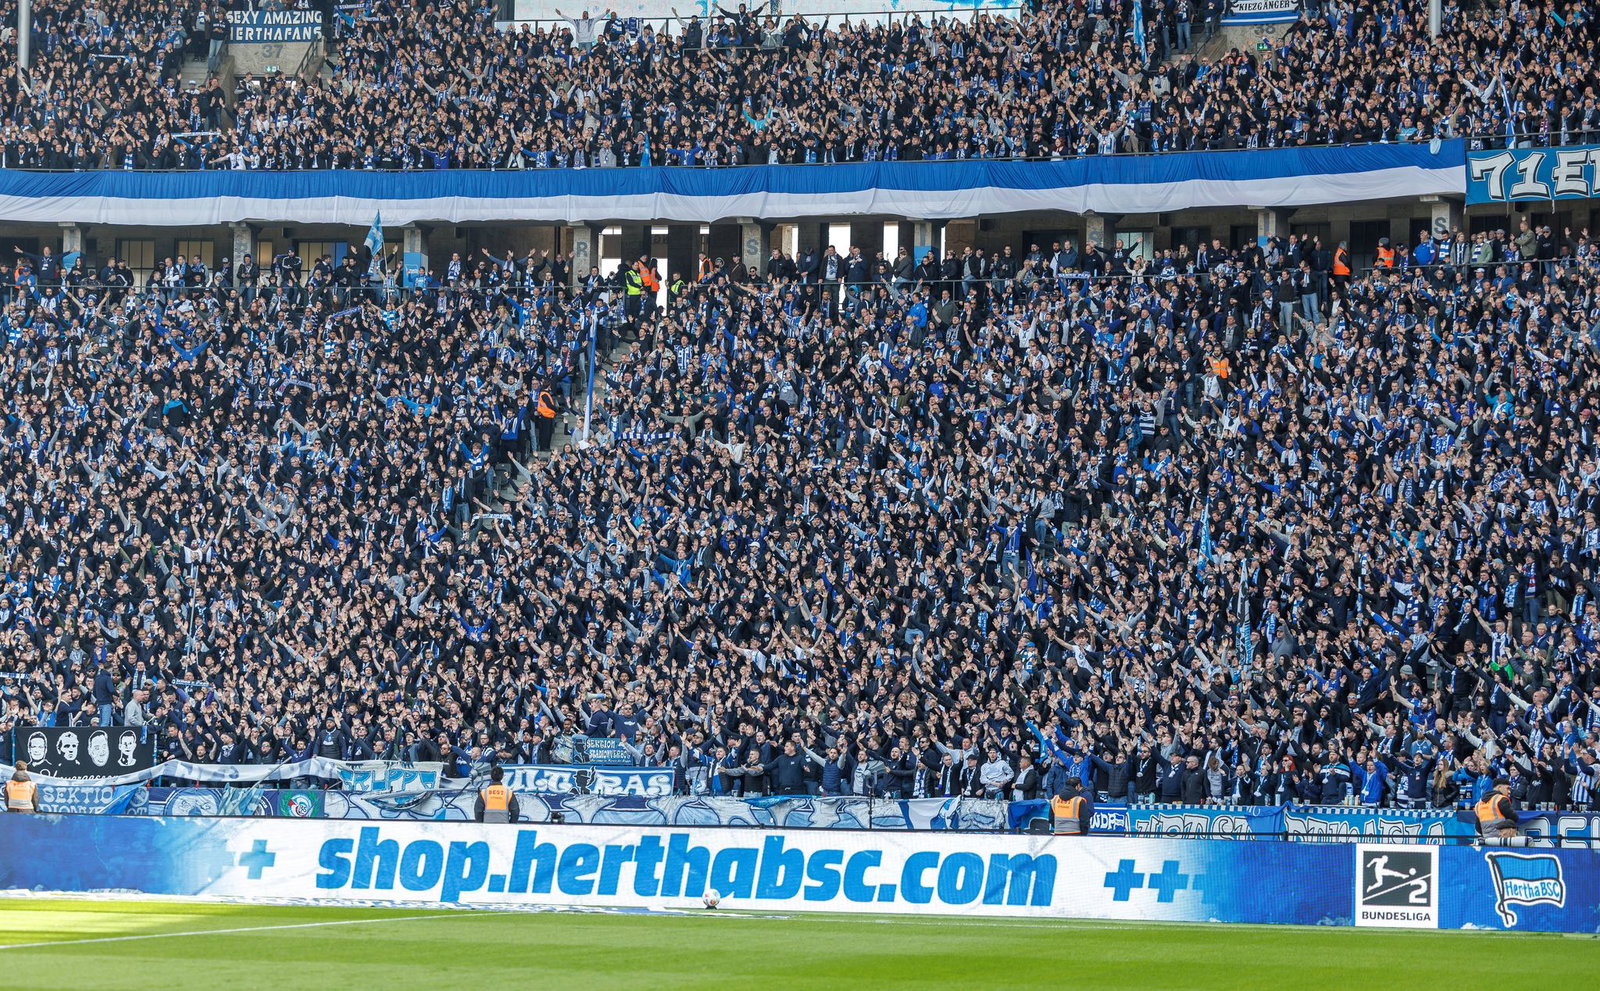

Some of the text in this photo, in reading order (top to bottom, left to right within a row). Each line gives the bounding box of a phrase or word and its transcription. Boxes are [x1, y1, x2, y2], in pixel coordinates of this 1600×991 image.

[226, 10, 322, 25] SEXY AMAZING
[262, 45, 284, 58] 37
[1434, 216, 1447, 235] S
[576, 241, 588, 258] R
[42, 785, 114, 804] SEKTIO
[316, 826, 1057, 906] shop.herthabsc.com
[1408, 879, 1428, 904] 2
[1361, 911, 1431, 921] BUNDESLIGA
